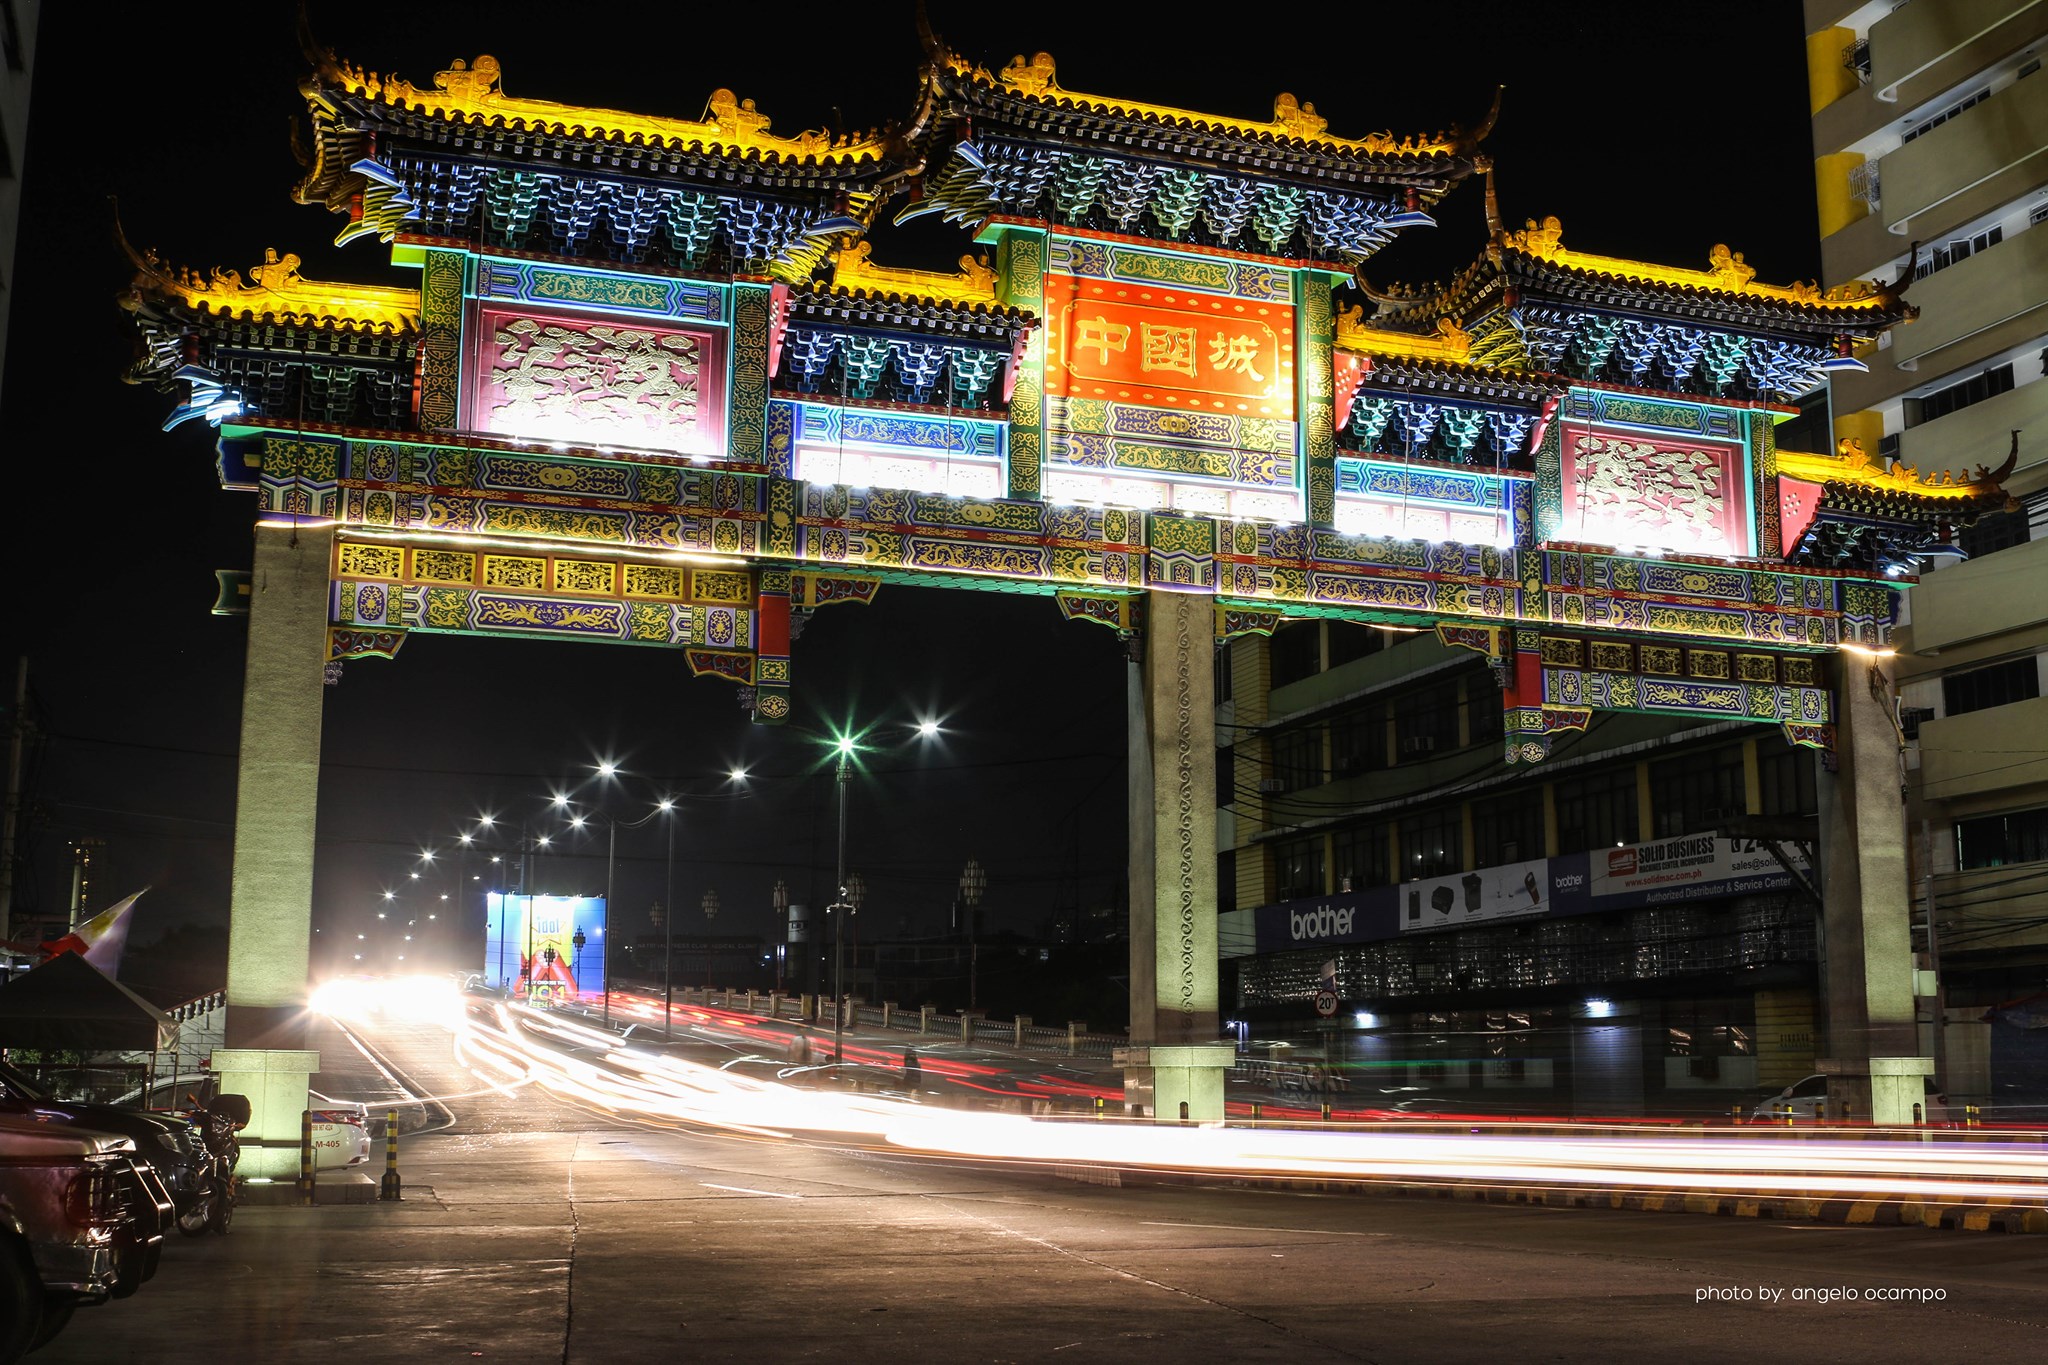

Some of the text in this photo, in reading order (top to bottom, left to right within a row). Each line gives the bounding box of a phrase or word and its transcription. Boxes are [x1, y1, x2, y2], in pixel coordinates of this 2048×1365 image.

[1074, 314, 1265, 383] 中國城
[1638, 836, 1714, 864] SOLID BUSINESS
[1555, 875, 1584, 888] brother
[1624, 869, 1702, 887] www.solidmac.com.ph
[1646, 876, 1792, 904] Authorized Distributor & Service Center
[536, 916, 560, 933] idol
[1291, 904, 1356, 941] brother
[315, 1140, 340, 1148] M-405
